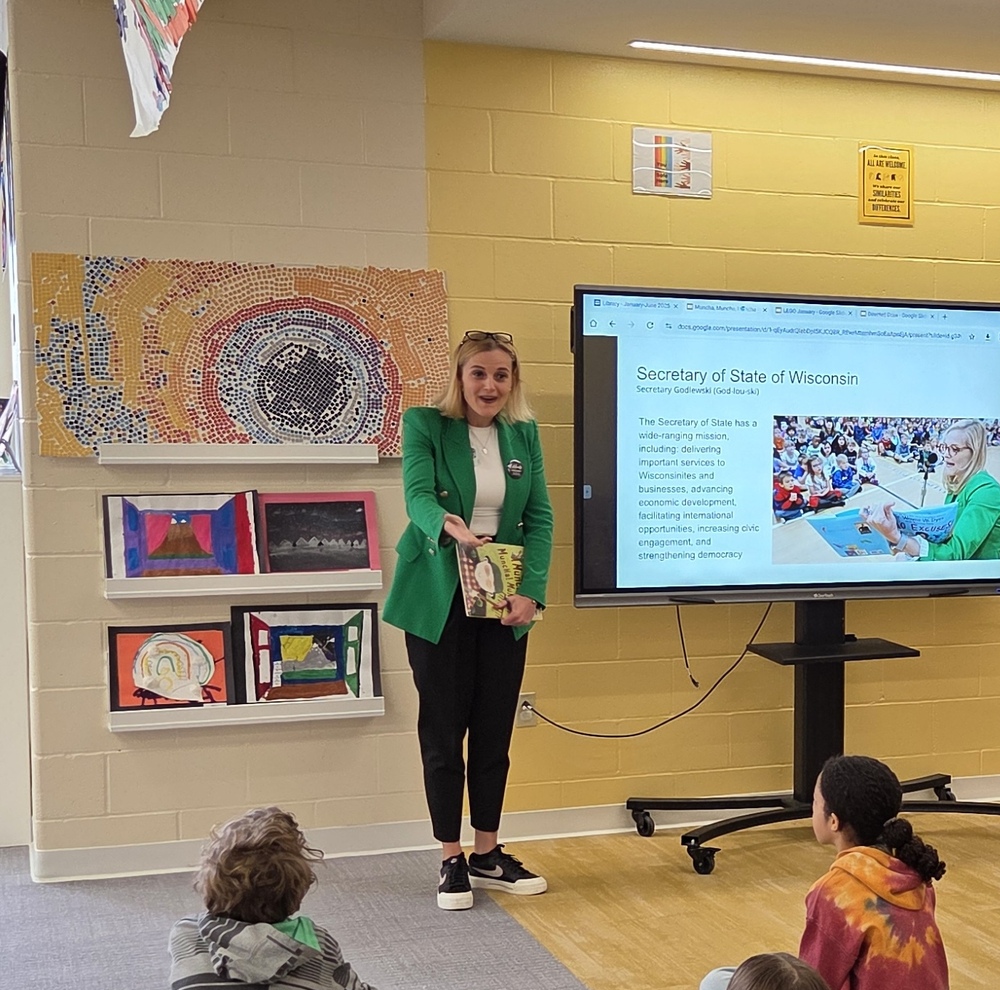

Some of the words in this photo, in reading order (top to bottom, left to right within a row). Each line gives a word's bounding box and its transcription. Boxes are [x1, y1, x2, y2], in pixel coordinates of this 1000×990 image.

[876, 160, 884, 168] ARE
[873, 190, 901, 198] SIMILARITIES
[636, 366, 708, 385] Secretary
[712, 368, 726, 383] of
[730, 369, 767, 384] State
[771, 370, 785, 384] of
[788, 370, 858, 385] Wisconsin
[636, 385, 672, 395] Secretary
[674, 386, 712, 394] Godlewski
[639, 418, 655, 426] The
[658, 418, 698, 428] Secretary
[700, 418, 709, 426] of
[711, 419, 732, 427] State
[735, 419, 750, 427] has
[639, 432, 693, 441] wide-ranging
[695, 432, 730, 441] mission,
[639, 445, 679, 454] including:
[681, 445, 721, 455] delivering
[639, 458, 678, 468] important
[717, 459, 725, 467] to
[638, 485, 688, 494] businesses,
[691, 485, 733, 495] advancing
[681, 499, 737, 507] development,
[638, 512, 680, 521] facilitating
[683, 511, 733, 519] international
[638, 525, 695, 534] opportunities,
[697, 524, 739, 534] increasing
[741, 524, 760, 532] civic
[638, 539, 693, 548] engagement,
[695, 538, 711, 546] and
[638, 552, 696, 561] strengthening
[698, 551, 743, 560] democracy
